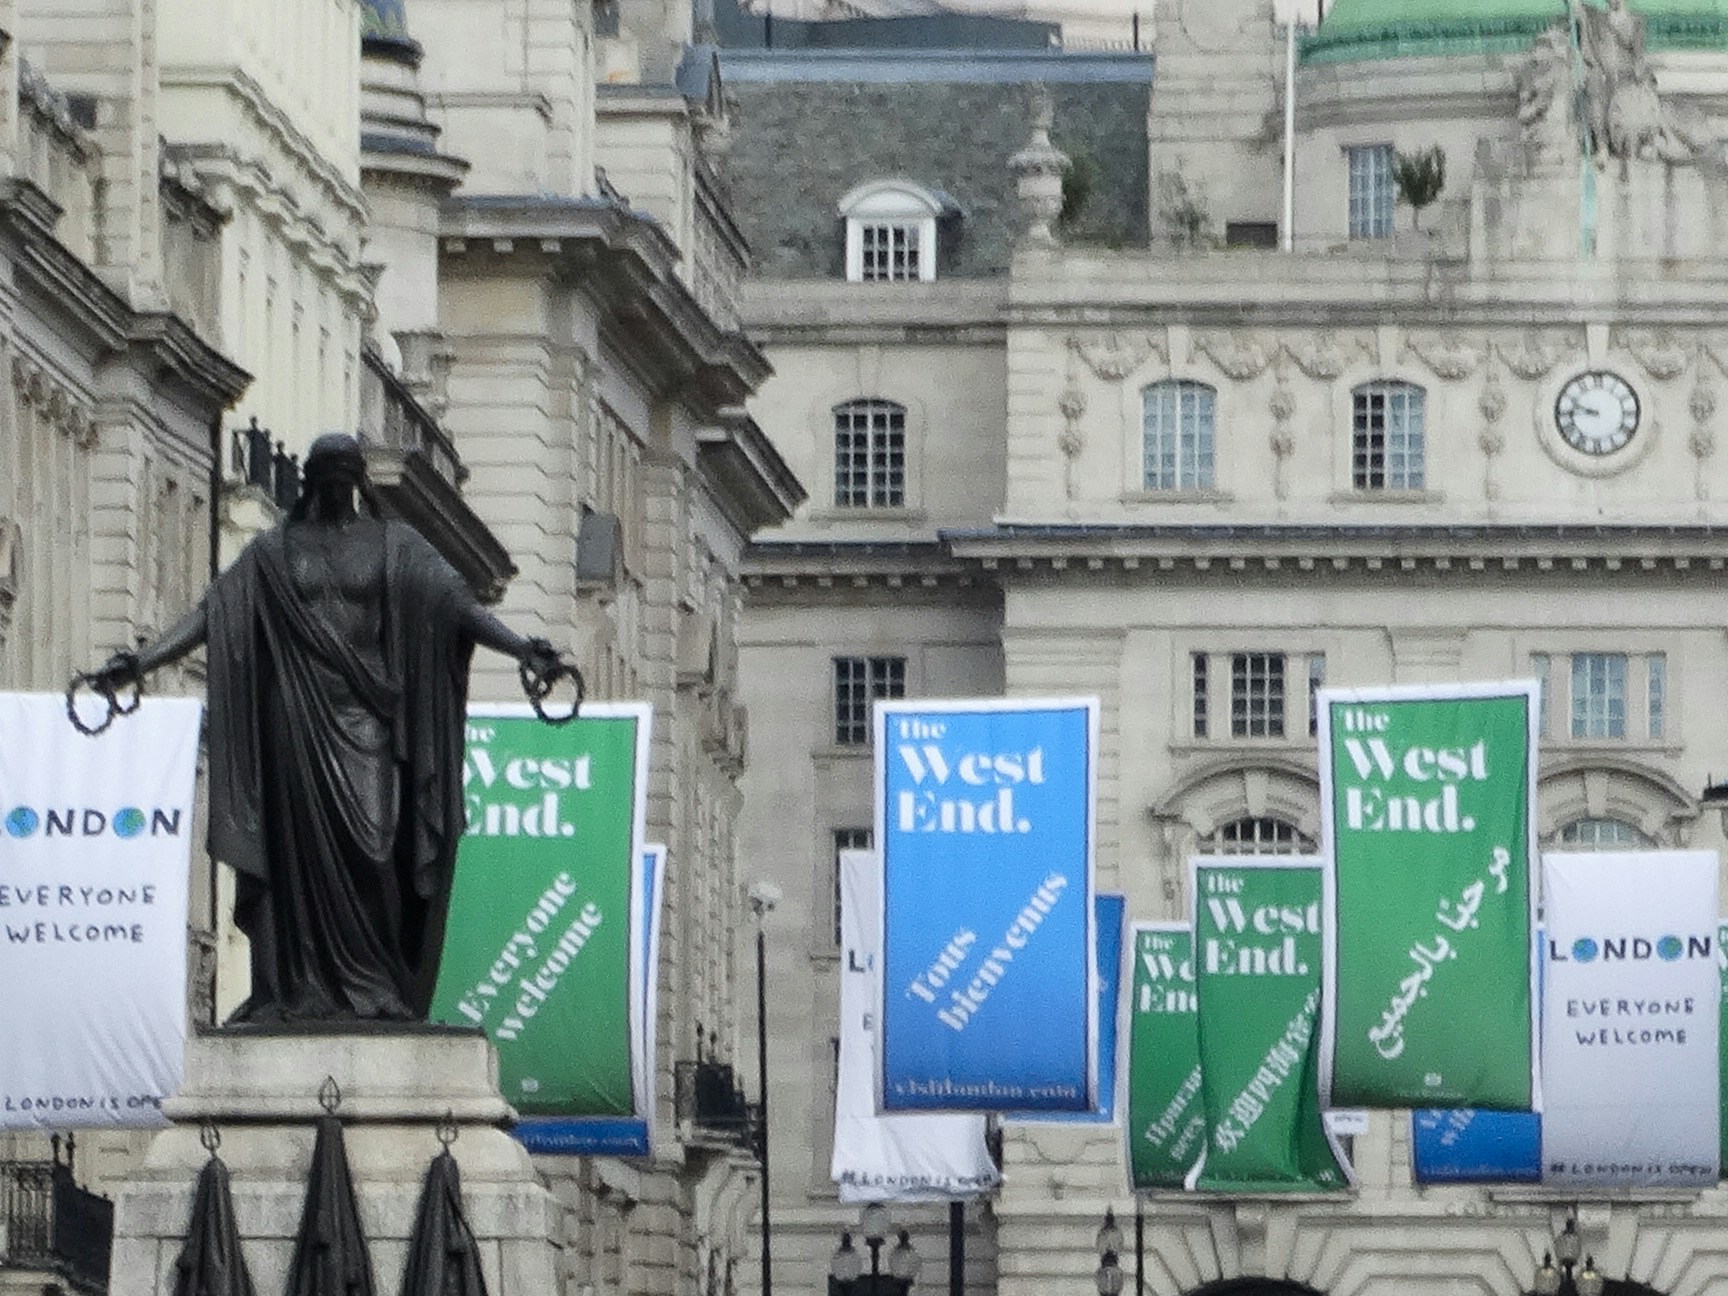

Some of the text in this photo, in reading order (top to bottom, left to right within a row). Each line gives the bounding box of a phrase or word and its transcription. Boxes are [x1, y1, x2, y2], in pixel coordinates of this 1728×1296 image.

[465, 726, 495, 743] he
[899, 718, 946, 740] the
[1343, 709, 1389, 733] the
[464, 748, 594, 790] West
[899, 743, 1046, 786] West
[1344, 738, 1491, 782] West
[899, 787, 1032, 834] End.
[1345, 784, 1476, 832] End.
[1208, 874, 1244, 893] the
[1207, 898, 1323, 934] West
[6, 922, 145, 944] WELCOME
[458, 871, 578, 1025] Everyone
[1144, 936, 1175, 951] the
[1549, 934, 1712, 963] LONDON
[905, 925, 978, 1004] Tous
[937, 868, 1069, 1032] bienvenus
[1205, 937, 1309, 976] End.
[496, 902, 604, 1041] welcome
[1141, 952, 1196, 982] We
[1566, 997, 1695, 1017] EVERYONE
[1576, 1029, 1687, 1045] WELCOME
[127, 1094, 164, 1111] OPE
